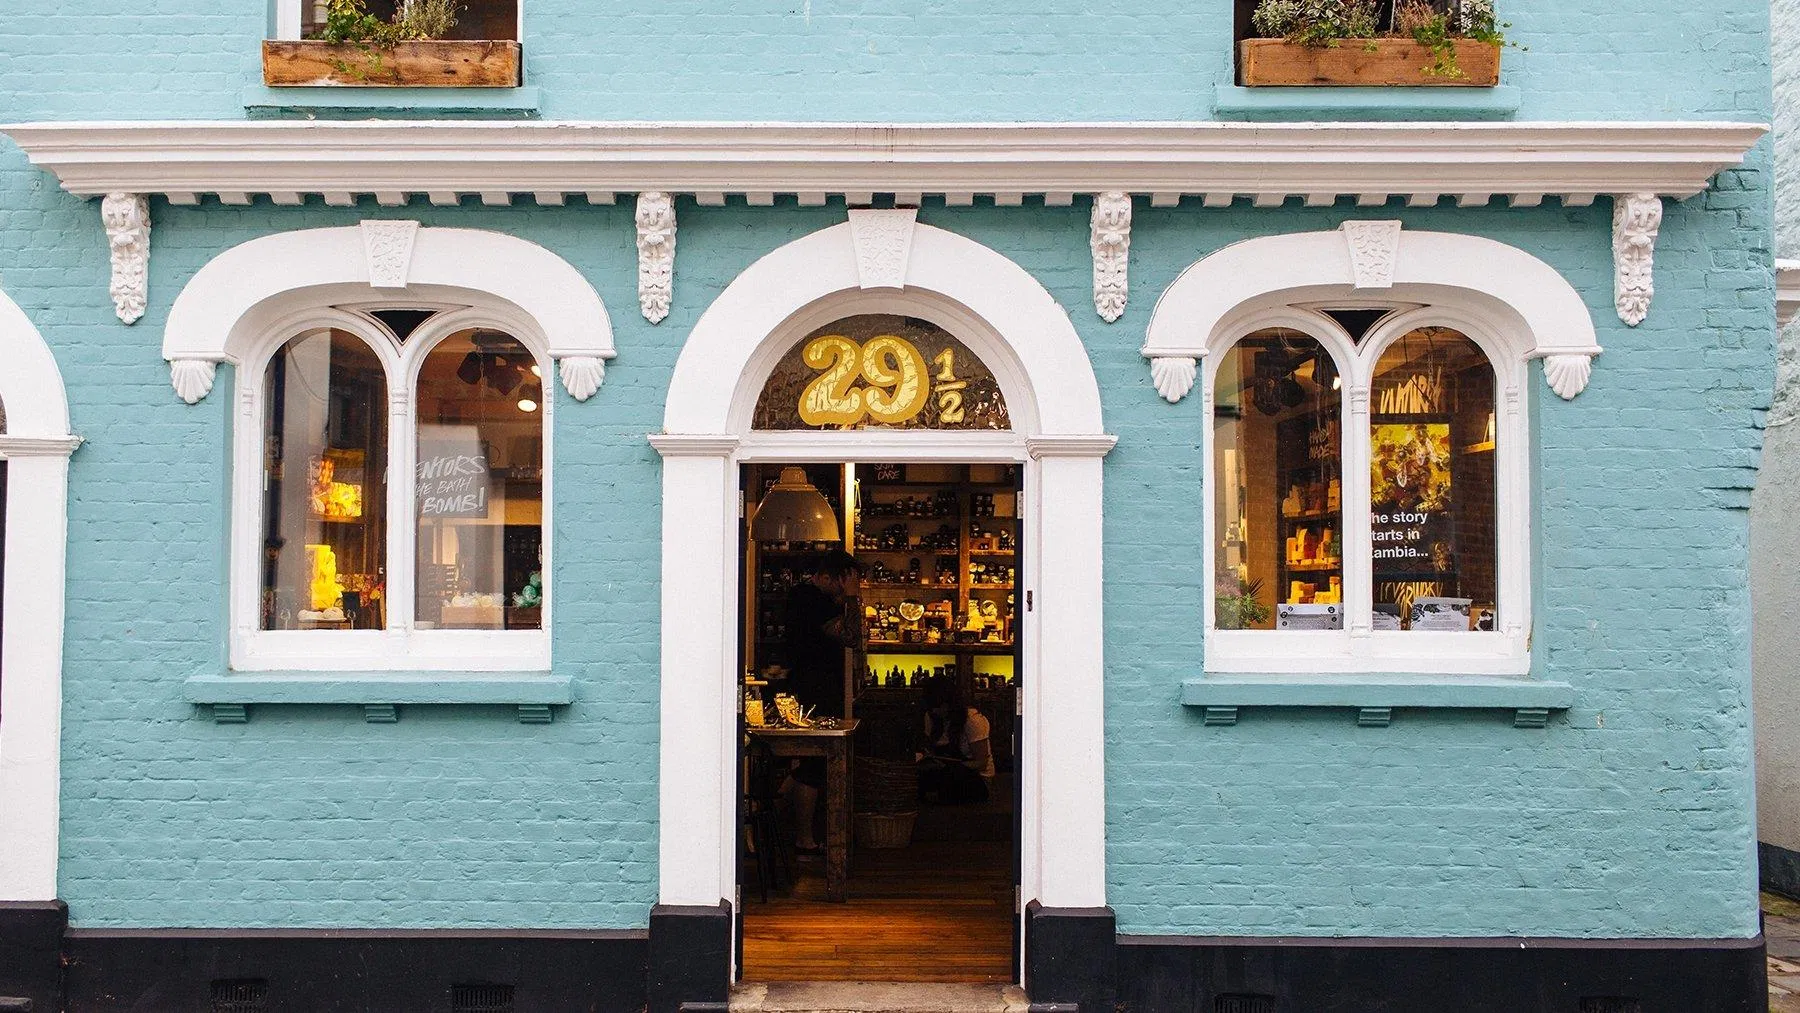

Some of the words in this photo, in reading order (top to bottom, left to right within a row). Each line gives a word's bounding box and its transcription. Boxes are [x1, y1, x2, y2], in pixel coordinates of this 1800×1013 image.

[798, 335, 930, 426] 29
[878, 470, 901, 481] CARE
[437, 477, 473, 494] BATH
[422, 486, 485, 513] BOMB!
[1392, 511, 1428, 524] story
[1407, 528, 1420, 540] in
[1372, 545, 1429, 558] ambia...
